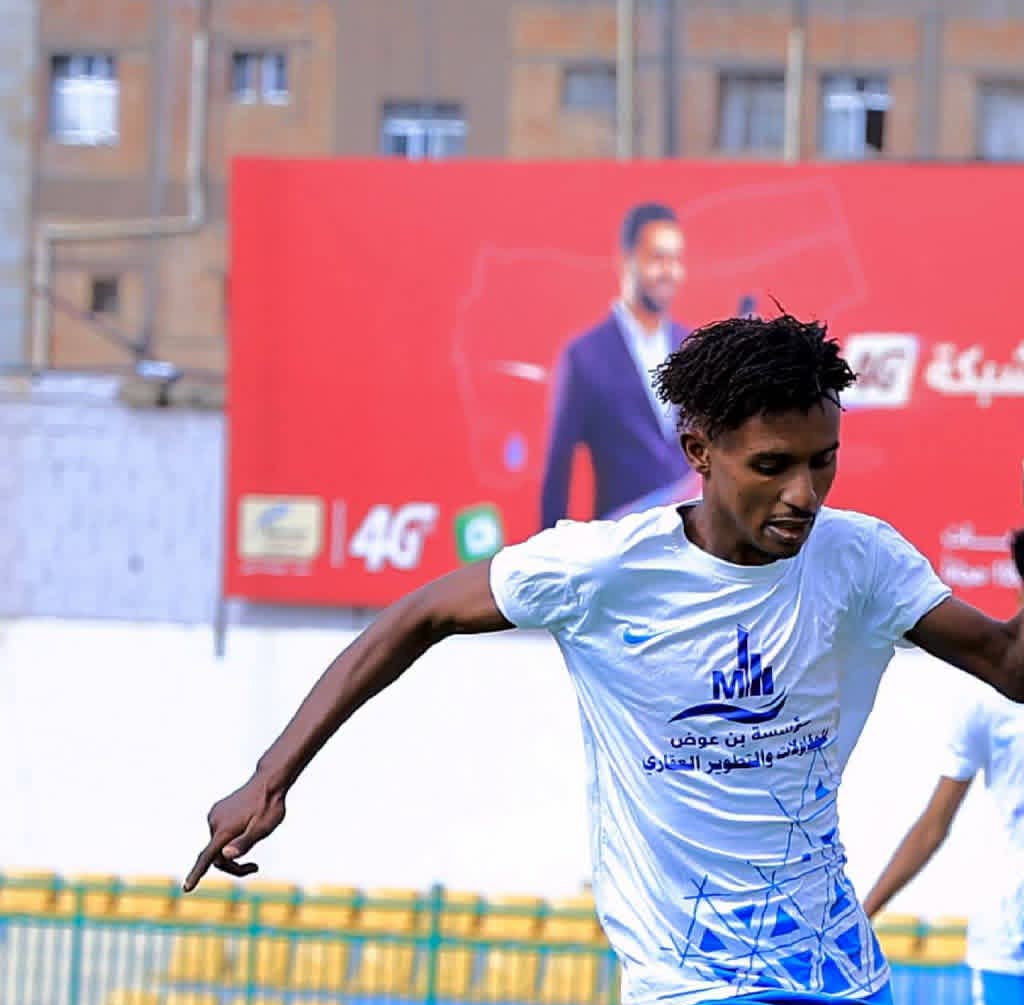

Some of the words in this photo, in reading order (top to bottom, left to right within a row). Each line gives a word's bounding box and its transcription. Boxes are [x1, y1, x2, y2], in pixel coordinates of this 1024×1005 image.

[350, 503, 440, 573] 4G
[670, 731, 719, 749] عوض
[724, 731, 746, 748] بن
[641, 754, 701, 776] العقاري
